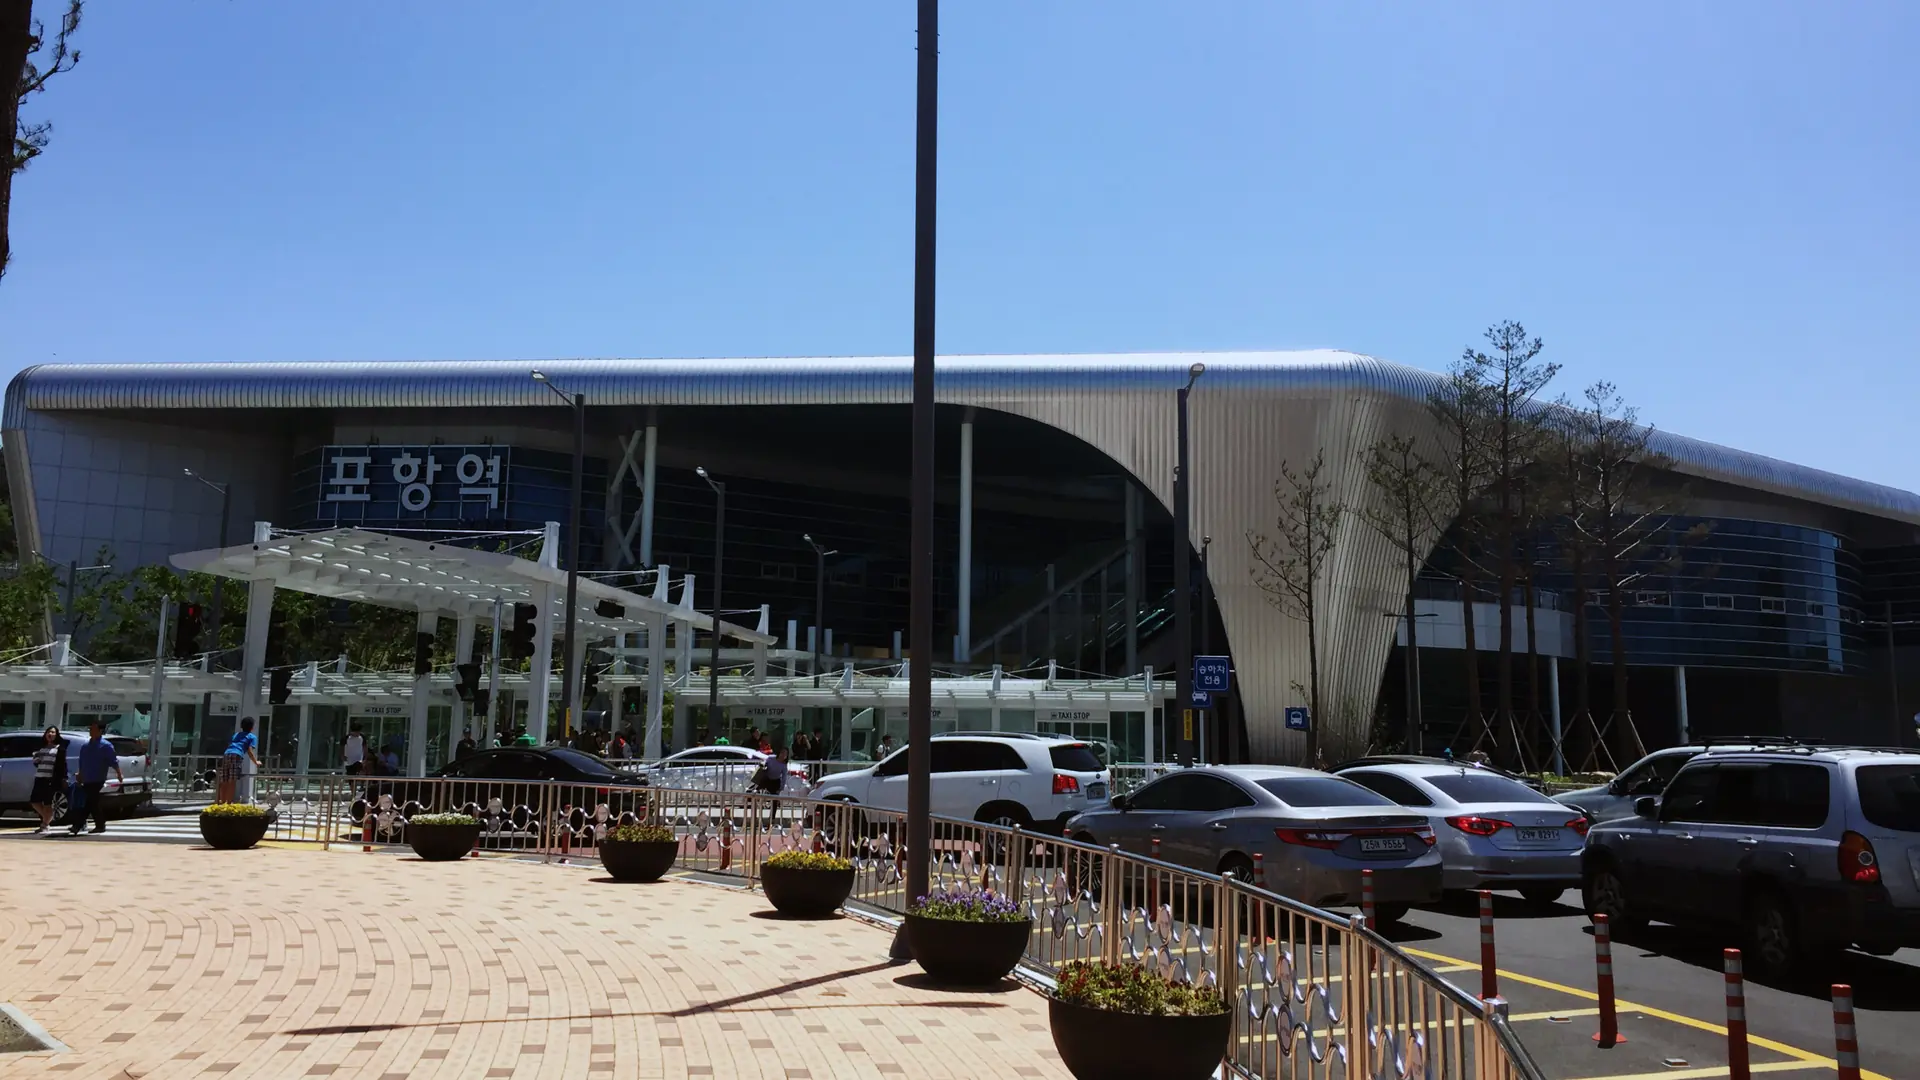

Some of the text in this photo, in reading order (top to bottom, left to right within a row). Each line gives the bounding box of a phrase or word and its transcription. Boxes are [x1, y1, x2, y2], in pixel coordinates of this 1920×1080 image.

[325, 452, 501, 512] 포항역
[1198, 664, 1226, 675] 승하차
[1204, 675, 1221, 686] 전용
[90, 704, 119, 712] TAXI STOP
[227, 705, 239, 713] TAX
[371, 706, 402, 714] TAXI STOP
[753, 708, 785, 716] TAXI STOP
[1058, 711, 1091, 720] TAXI STOP
[1382, 839, 1403, 849] 9556
